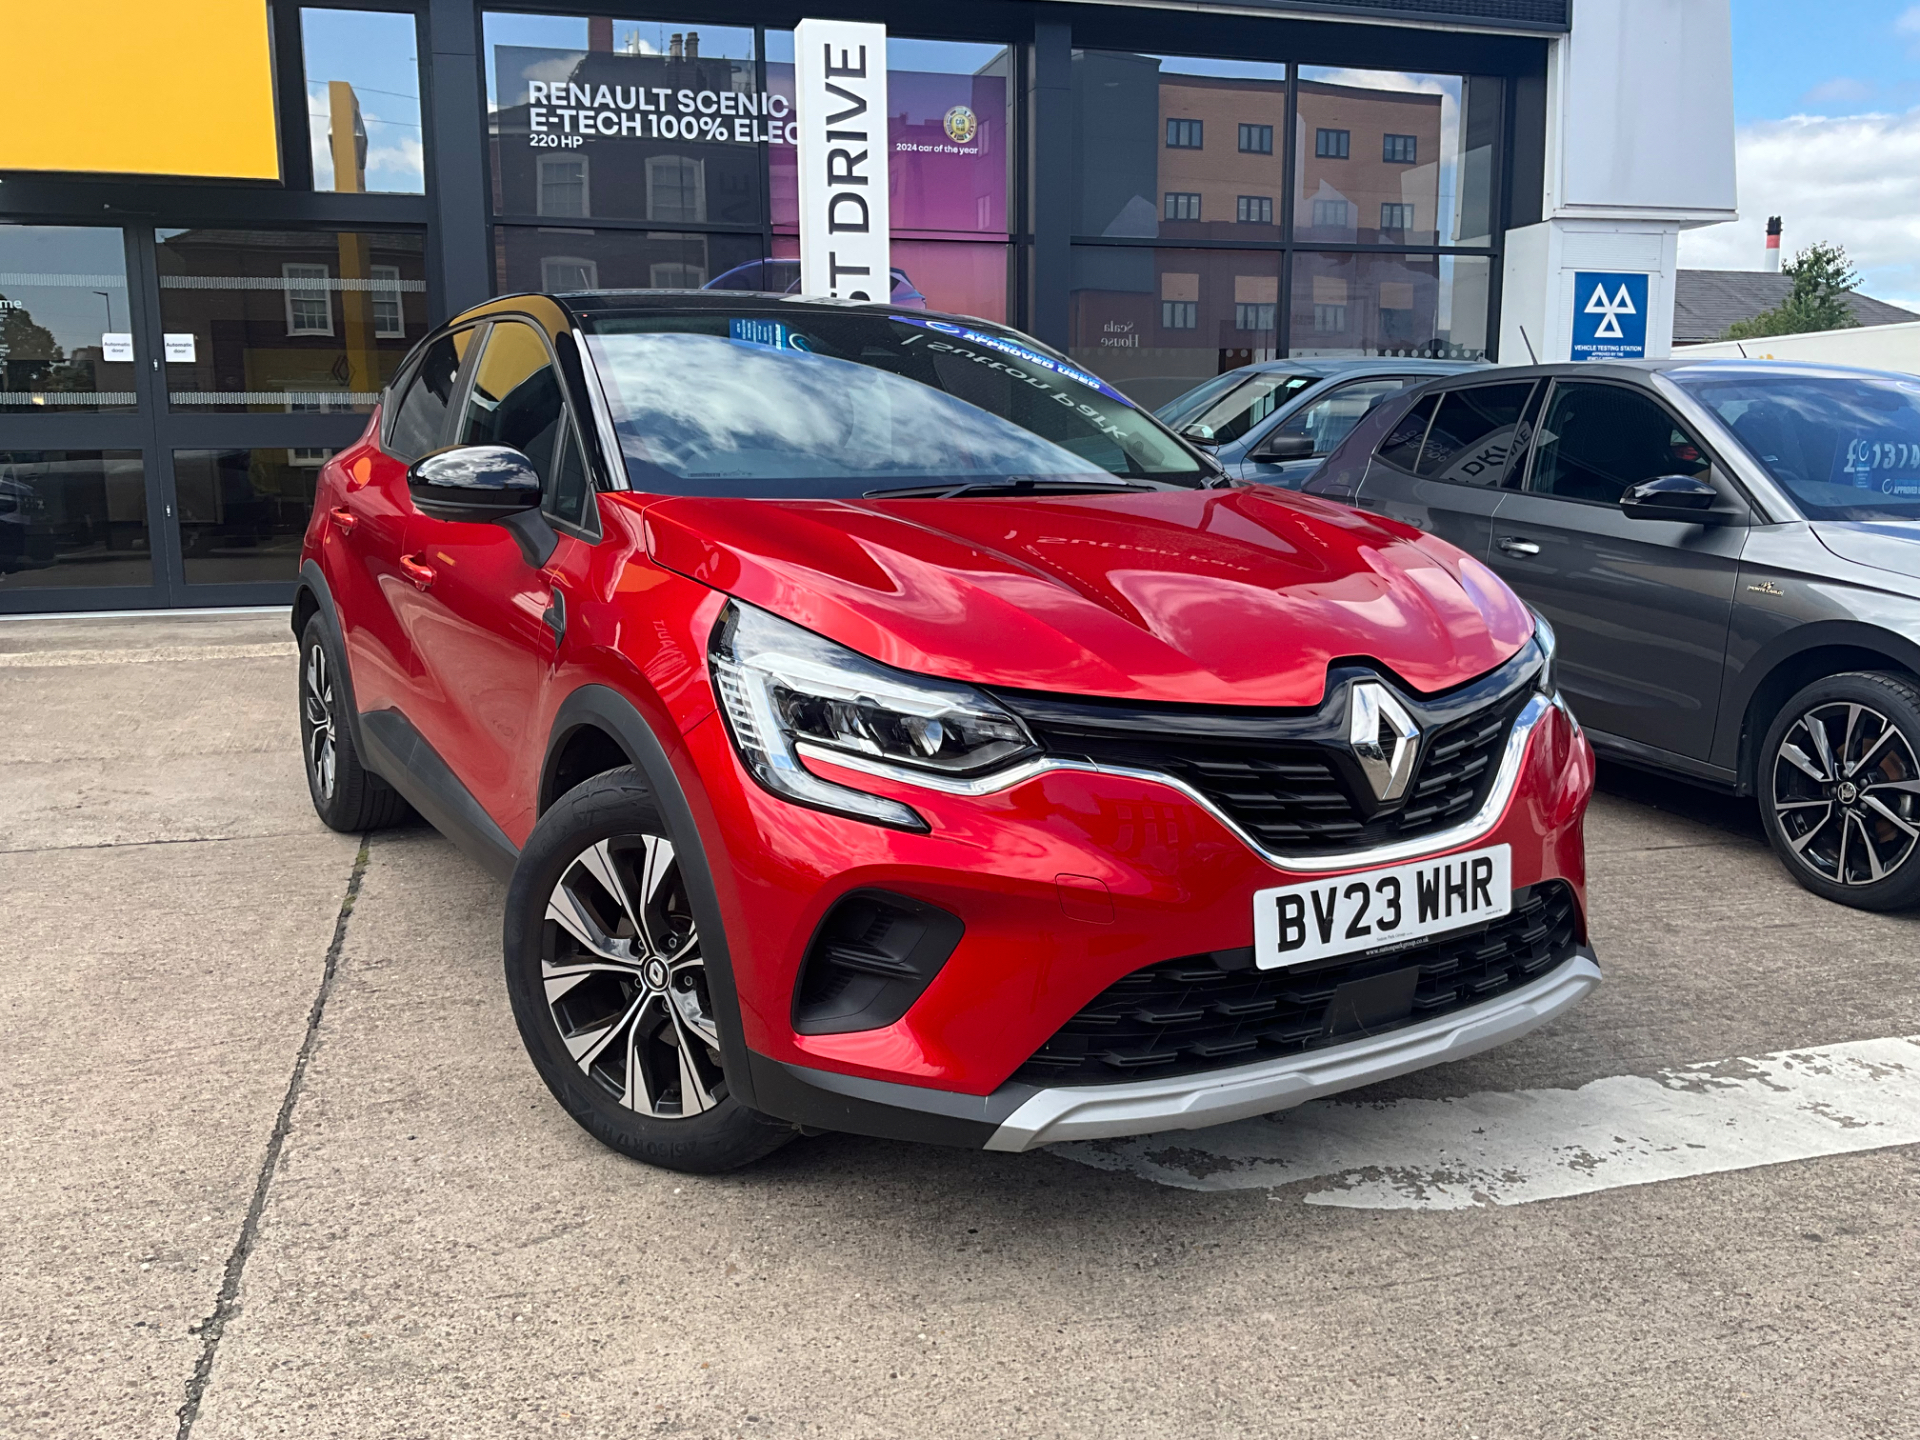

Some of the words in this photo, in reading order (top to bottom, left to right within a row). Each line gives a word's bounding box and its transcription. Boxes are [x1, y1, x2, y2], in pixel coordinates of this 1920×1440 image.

[528, 80, 672, 112] RENAULT
[677, 89, 789, 118] SCENIC
[529, 107, 642, 137] E-TECH
[648, 114, 729, 141] 100%
[529, 134, 558, 148] 220
[561, 136, 583, 148] HP
[824, 43, 869, 235] DRIVE
[896, 143, 917, 151] 2024
[933, 145, 943, 153] of
[944, 145, 958, 154] the
[959, 147, 978, 155] year
[962, 333, 1054, 369] APPROVED
[1057, 367, 1100, 390] USED
[1893, 486, 1918, 495] APPROVED
[1275, 876, 1402, 953] BV23
[1416, 856, 1493, 924] WHR
